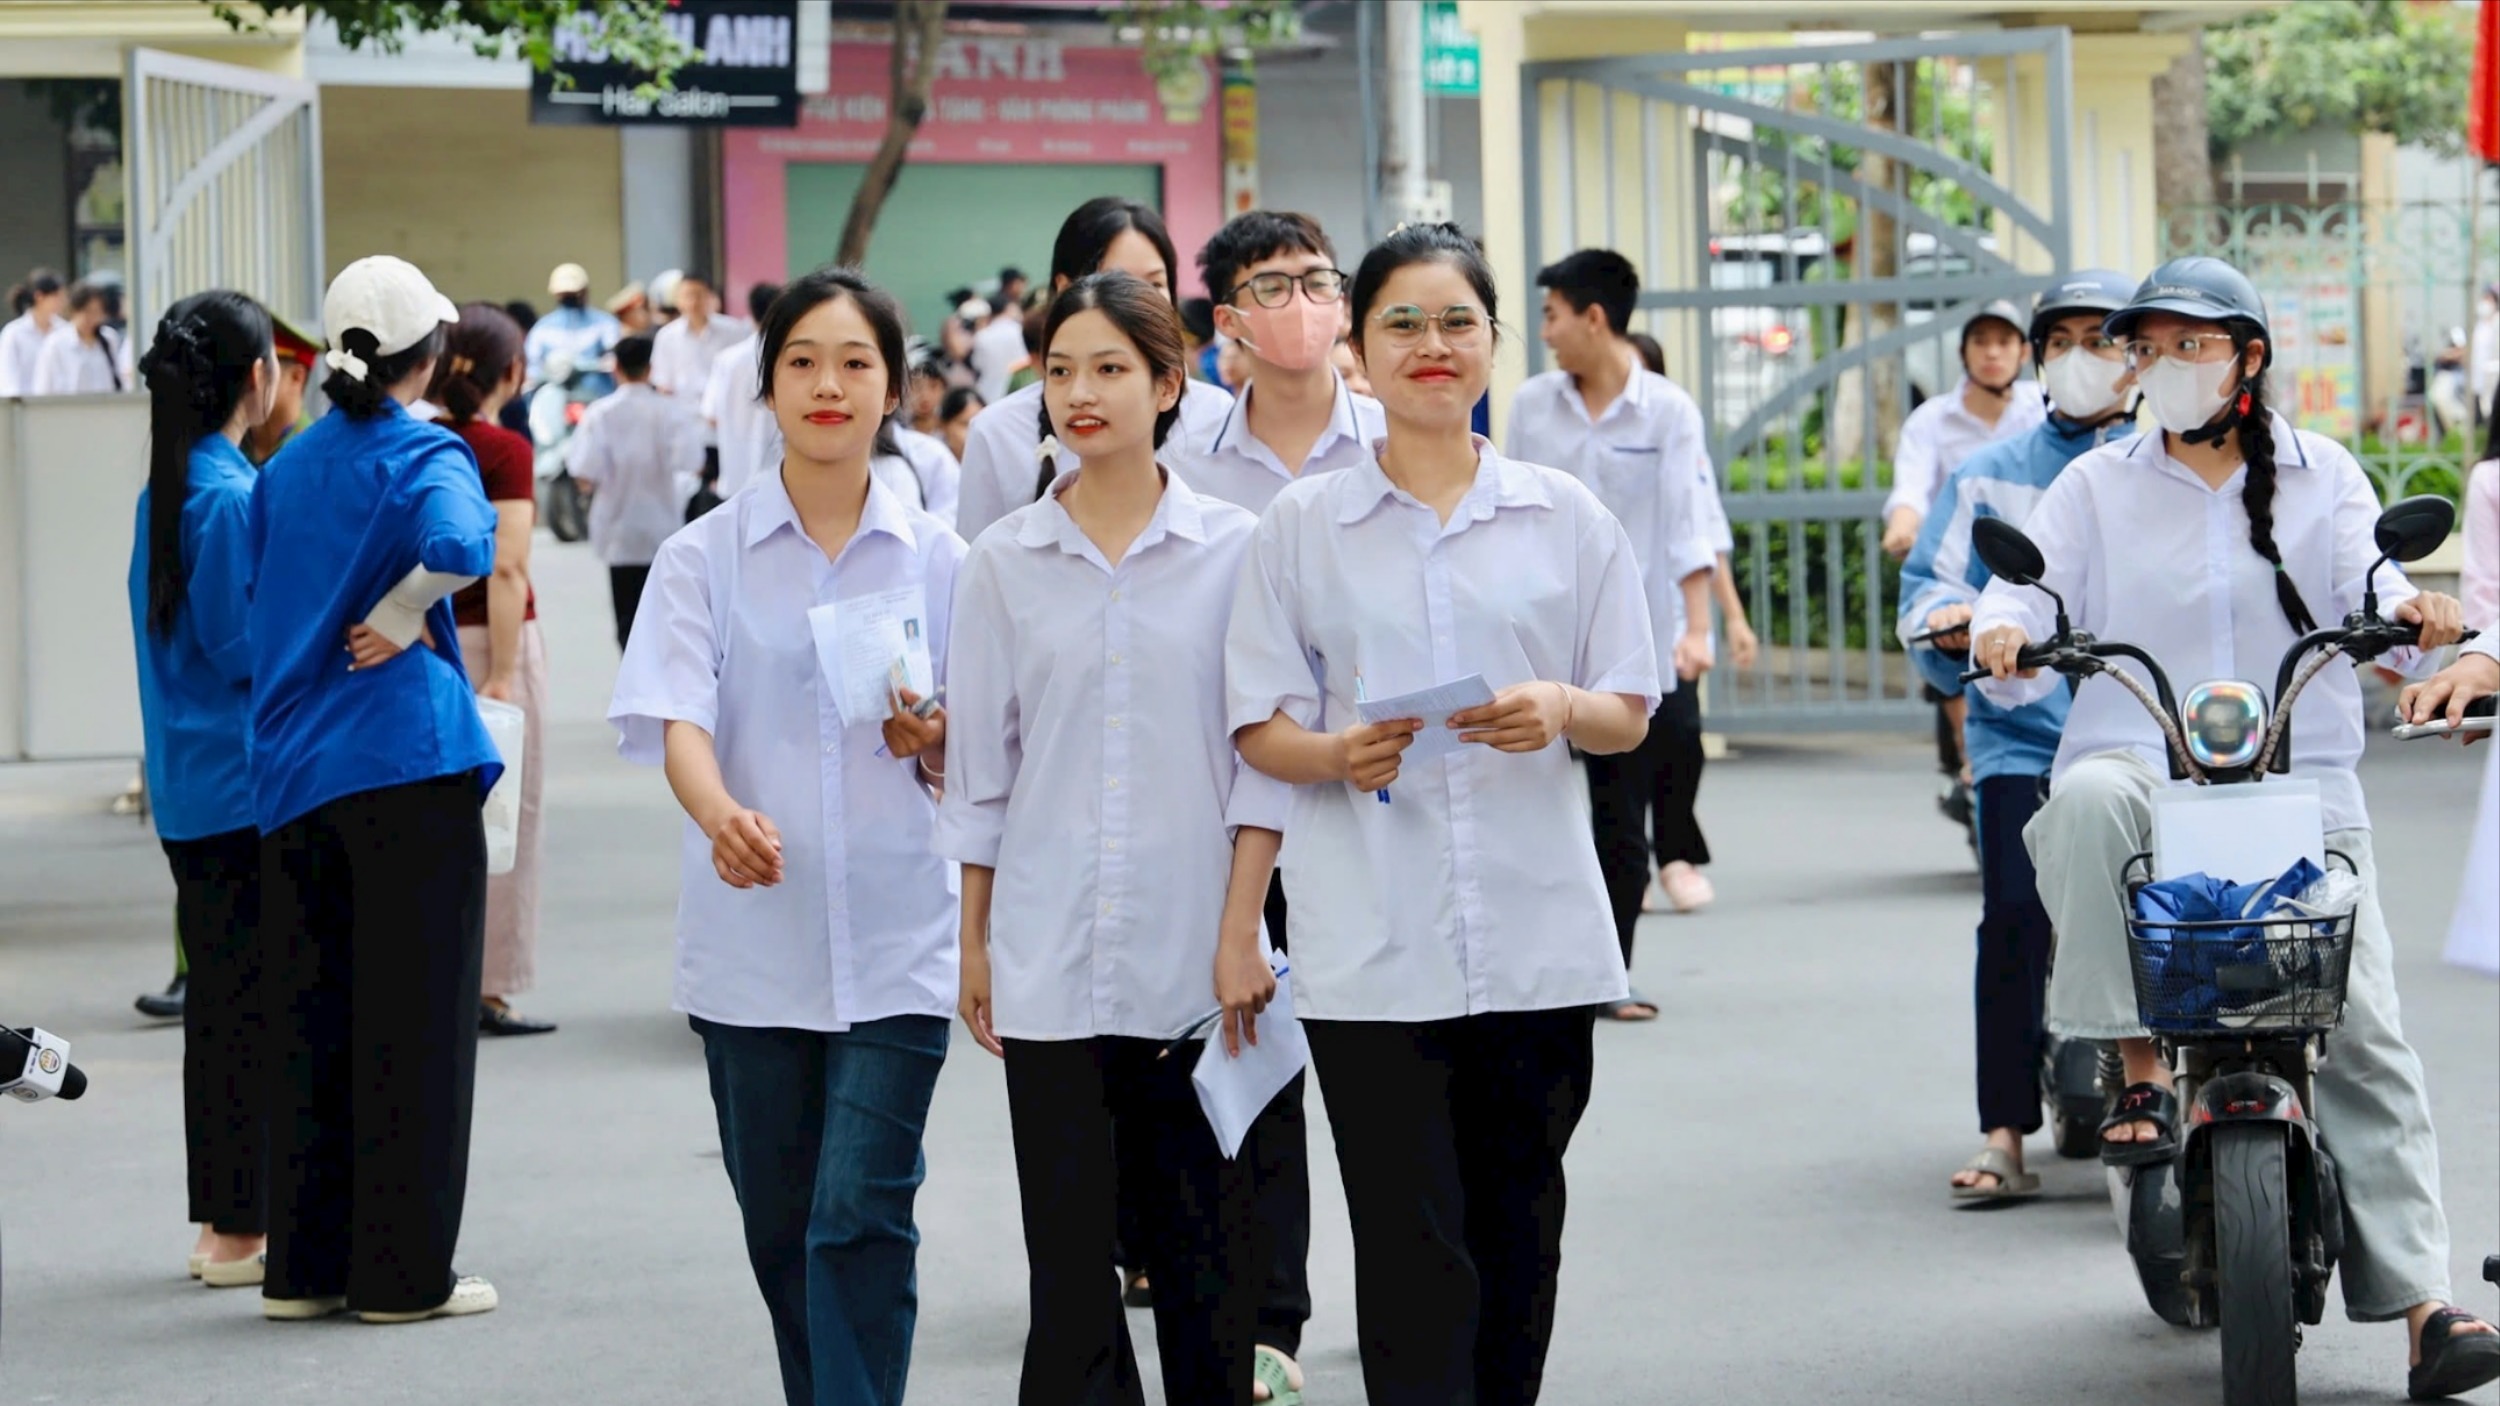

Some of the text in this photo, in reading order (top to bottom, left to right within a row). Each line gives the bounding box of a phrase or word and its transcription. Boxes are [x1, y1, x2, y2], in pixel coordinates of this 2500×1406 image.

[704, 14, 791, 66] ANH
[904, 38, 1065, 81] ANH
[657, 85, 730, 117] Salon
